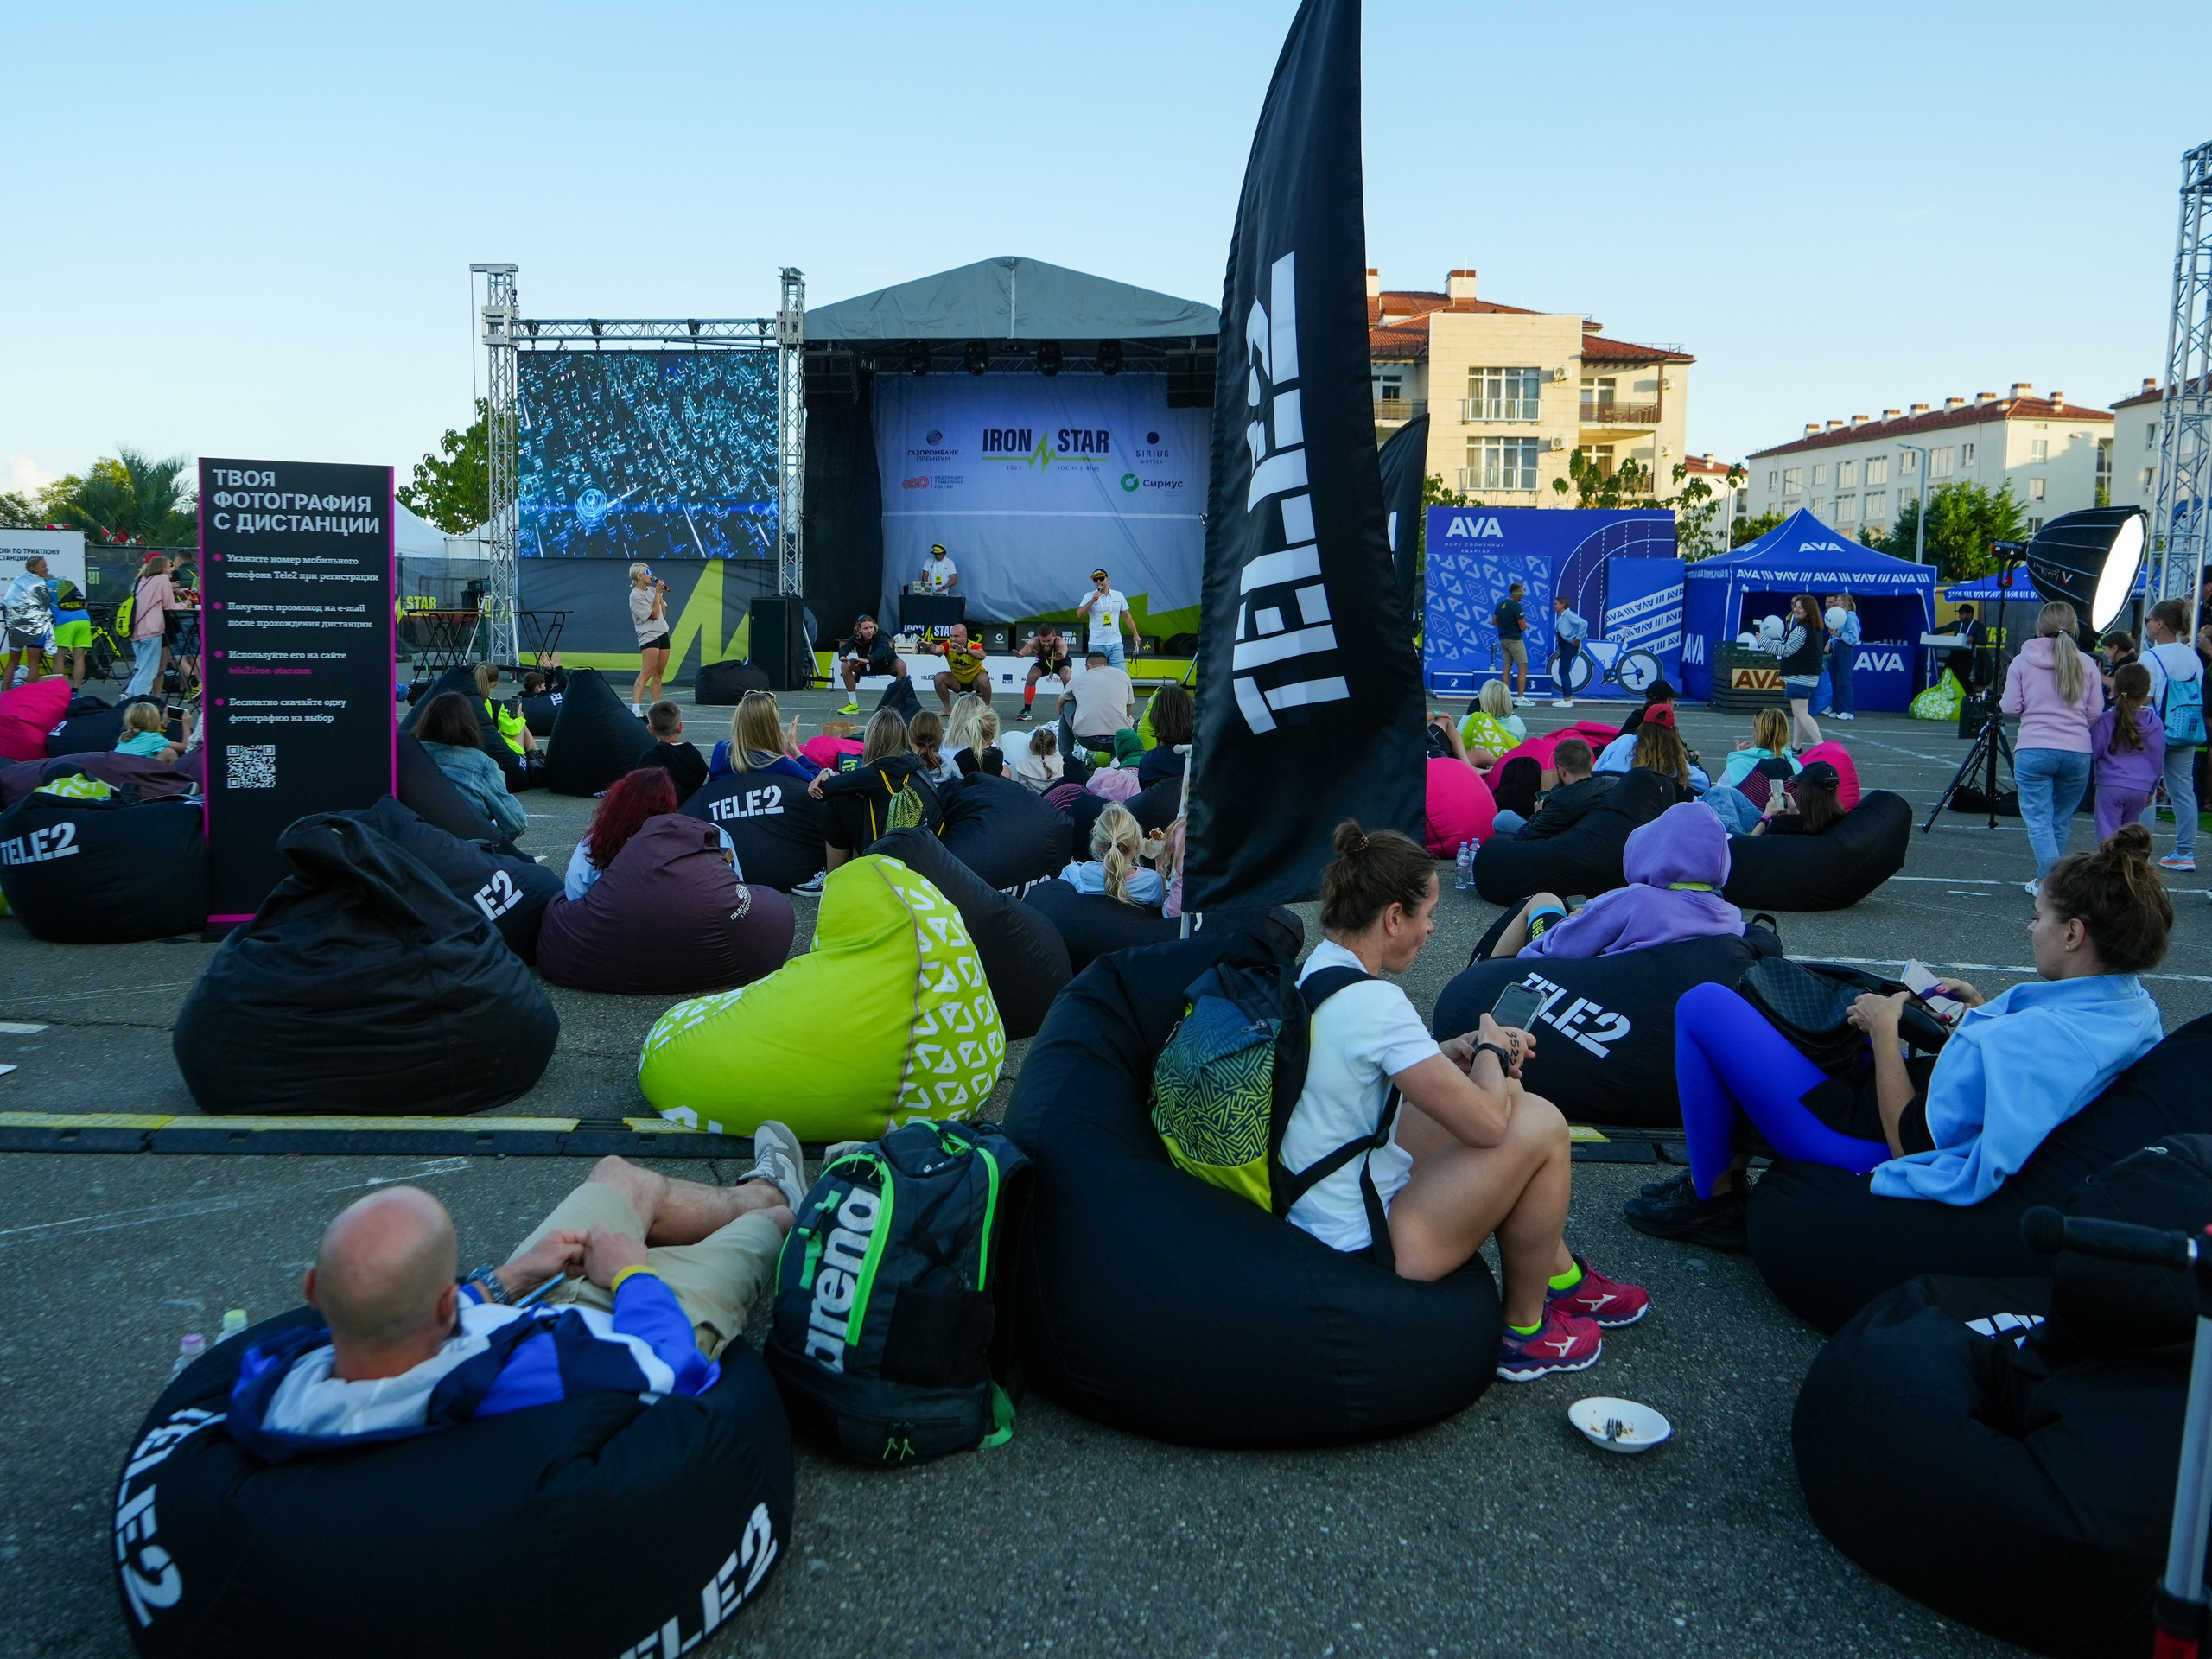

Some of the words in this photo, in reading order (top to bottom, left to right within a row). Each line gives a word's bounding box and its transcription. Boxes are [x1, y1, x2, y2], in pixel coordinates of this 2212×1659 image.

[982, 429, 1032, 452] IRON
[1057, 429, 1109, 453] STAR
[213, 468, 276, 487] ТВОЯ
[1143, 480, 1184, 489] Сириус
[213, 491, 372, 512] ФОТОГРАФИЯ
[213, 512, 231, 531] С
[236, 513, 379, 537] ДИСТАНЦИИ
[1446, 517, 1503, 538] AVA
[1798, 542, 1845, 553] AVA
[226, 554, 270, 564] Укажите
[270, 556, 301, 566] номер
[302, 556, 359, 566] мобильного
[226, 571, 272, 581] телефона
[273, 571, 297, 580] Tele2
[299, 573, 318, 582] при
[319, 574, 379, 582] регистрации
[1737, 569, 1761, 580] AVA
[1813, 572, 1838, 582] AVA
[1891, 574, 1916, 583] AVA
[227, 602, 275, 613] Получите
[276, 604, 323, 613] промокод
[337, 603, 365, 613] e-mail
[406, 596, 437, 609] STAR
[257, 620, 321, 628] прохождения
[321, 620, 372, 629] дистанции
[1681, 633, 1704, 665] AVA
[228, 651, 289, 661] Используйте
[321, 651, 347, 659] сайте
[1853, 652, 1905, 672] AVA
[228, 666, 312, 675] tele2.iron-star.com
[1450, 678, 1458, 688] 2
[1528, 680, 1536, 690] 3
[229, 698, 279, 707] Бесплатно
[280, 697, 323, 707] скачайте
[324, 699, 347, 709] одну
[229, 714, 289, 724] фотографию
[304, 714, 334, 723] выбор
[709, 785, 785, 822] TELE2
[0, 822, 79, 865] TELE2
[804, 1186, 881, 1374] arena
